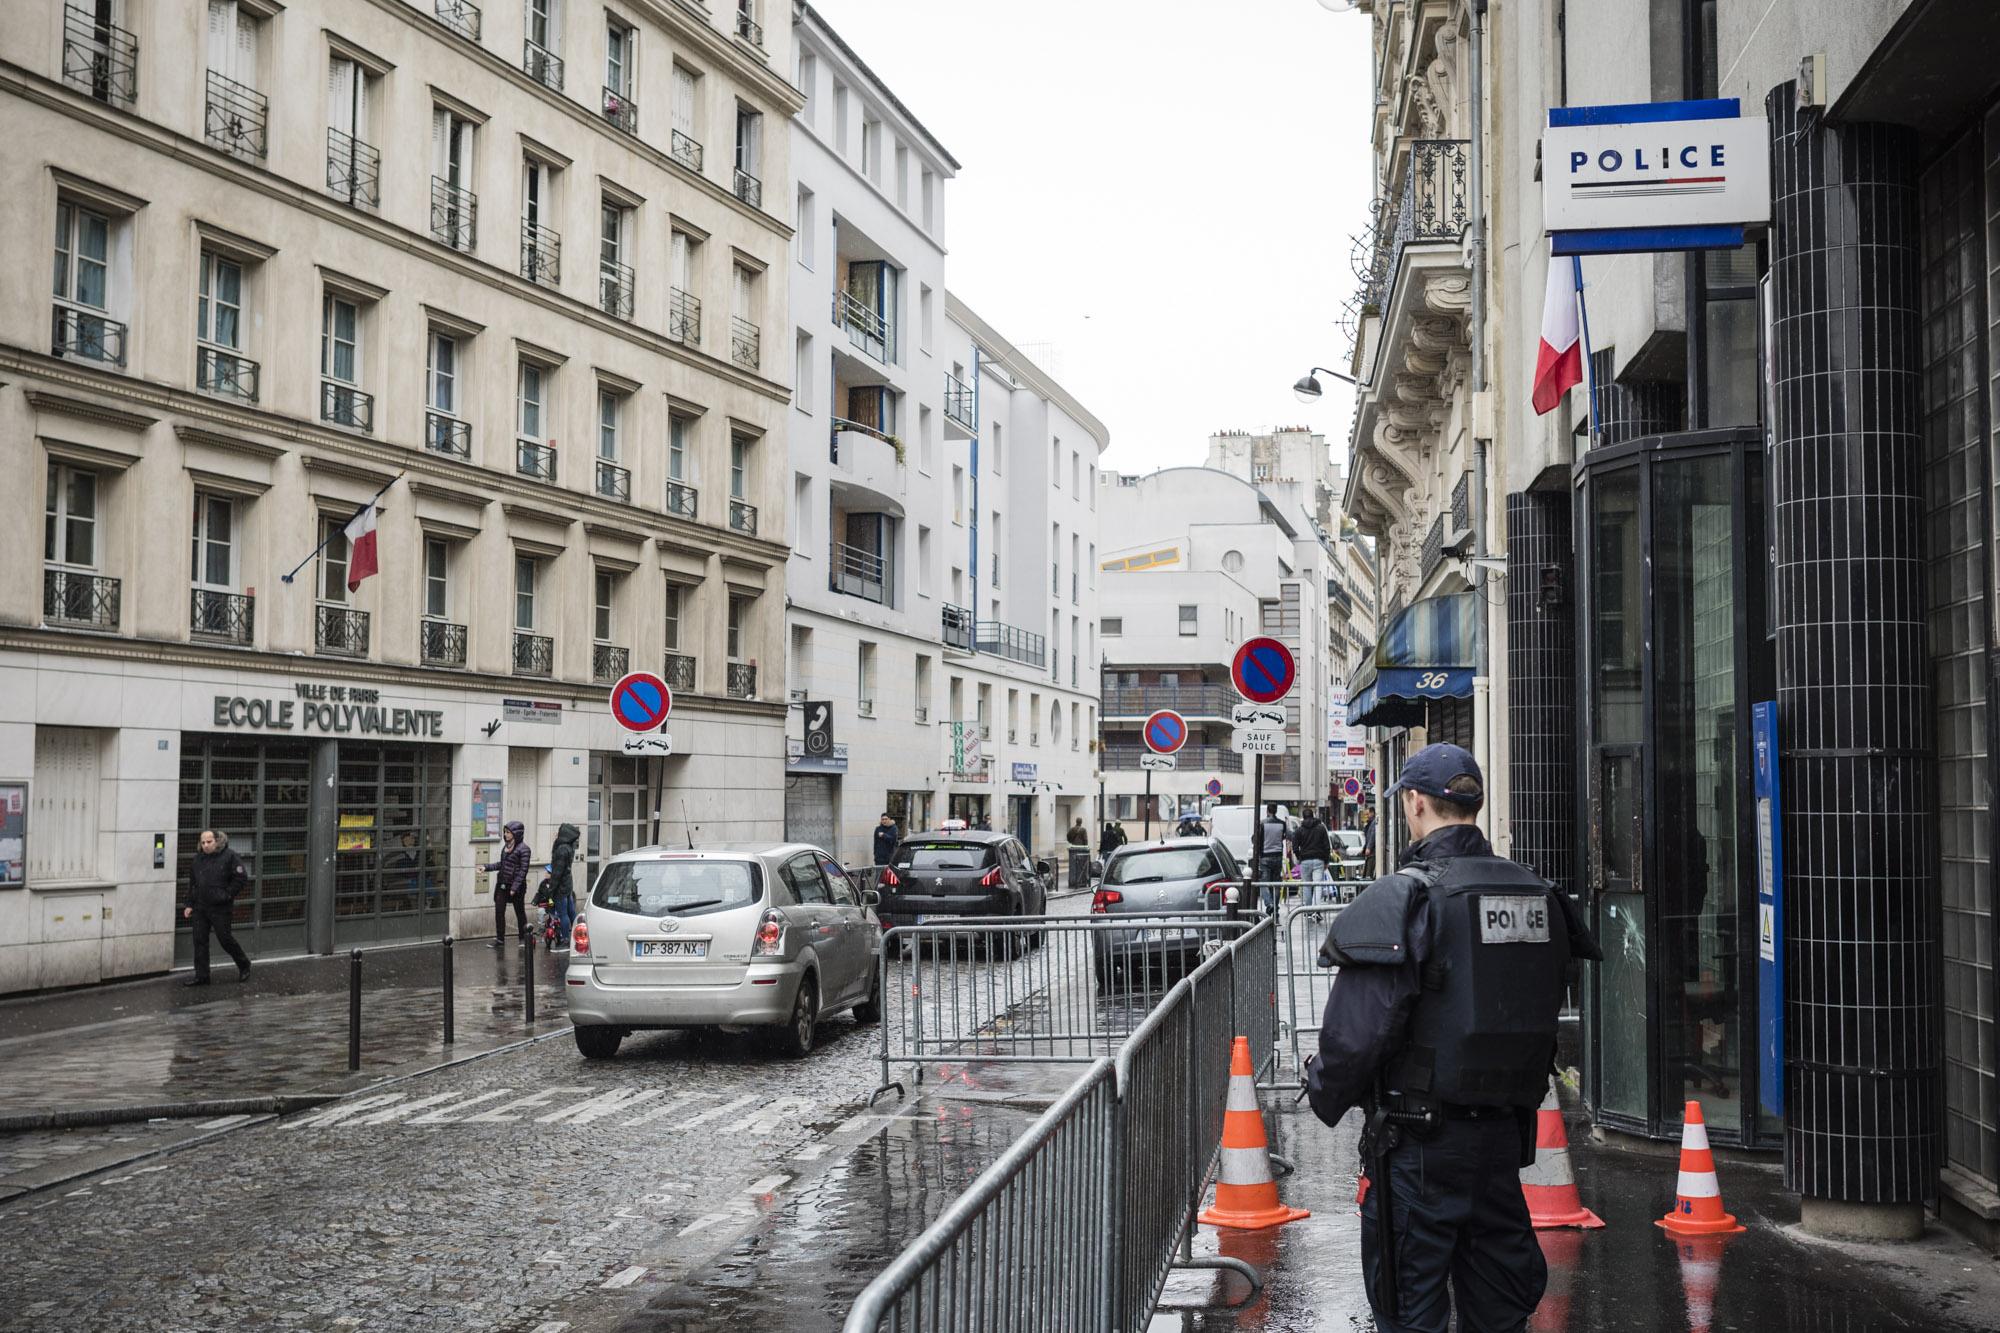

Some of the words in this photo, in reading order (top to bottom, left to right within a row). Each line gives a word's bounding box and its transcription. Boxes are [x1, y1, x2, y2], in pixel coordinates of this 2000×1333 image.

[1570, 144, 1725, 174] POLICE
[1416, 671, 1449, 689] 36
[295, 683, 326, 700] VILLE
[330, 686, 345, 702] DE
[349, 687, 379, 704] PARIS
[214, 696, 294, 729] ECOLE
[303, 702, 444, 737] POLYVALENTE
[1242, 742, 1276, 751] POLICE
[1247, 733, 1272, 741] SAUF
[1486, 910, 1544, 929] POLCE
[643, 942, 698, 954] DF-387-NX
[278, 1087, 817, 1134] RALENTIR
